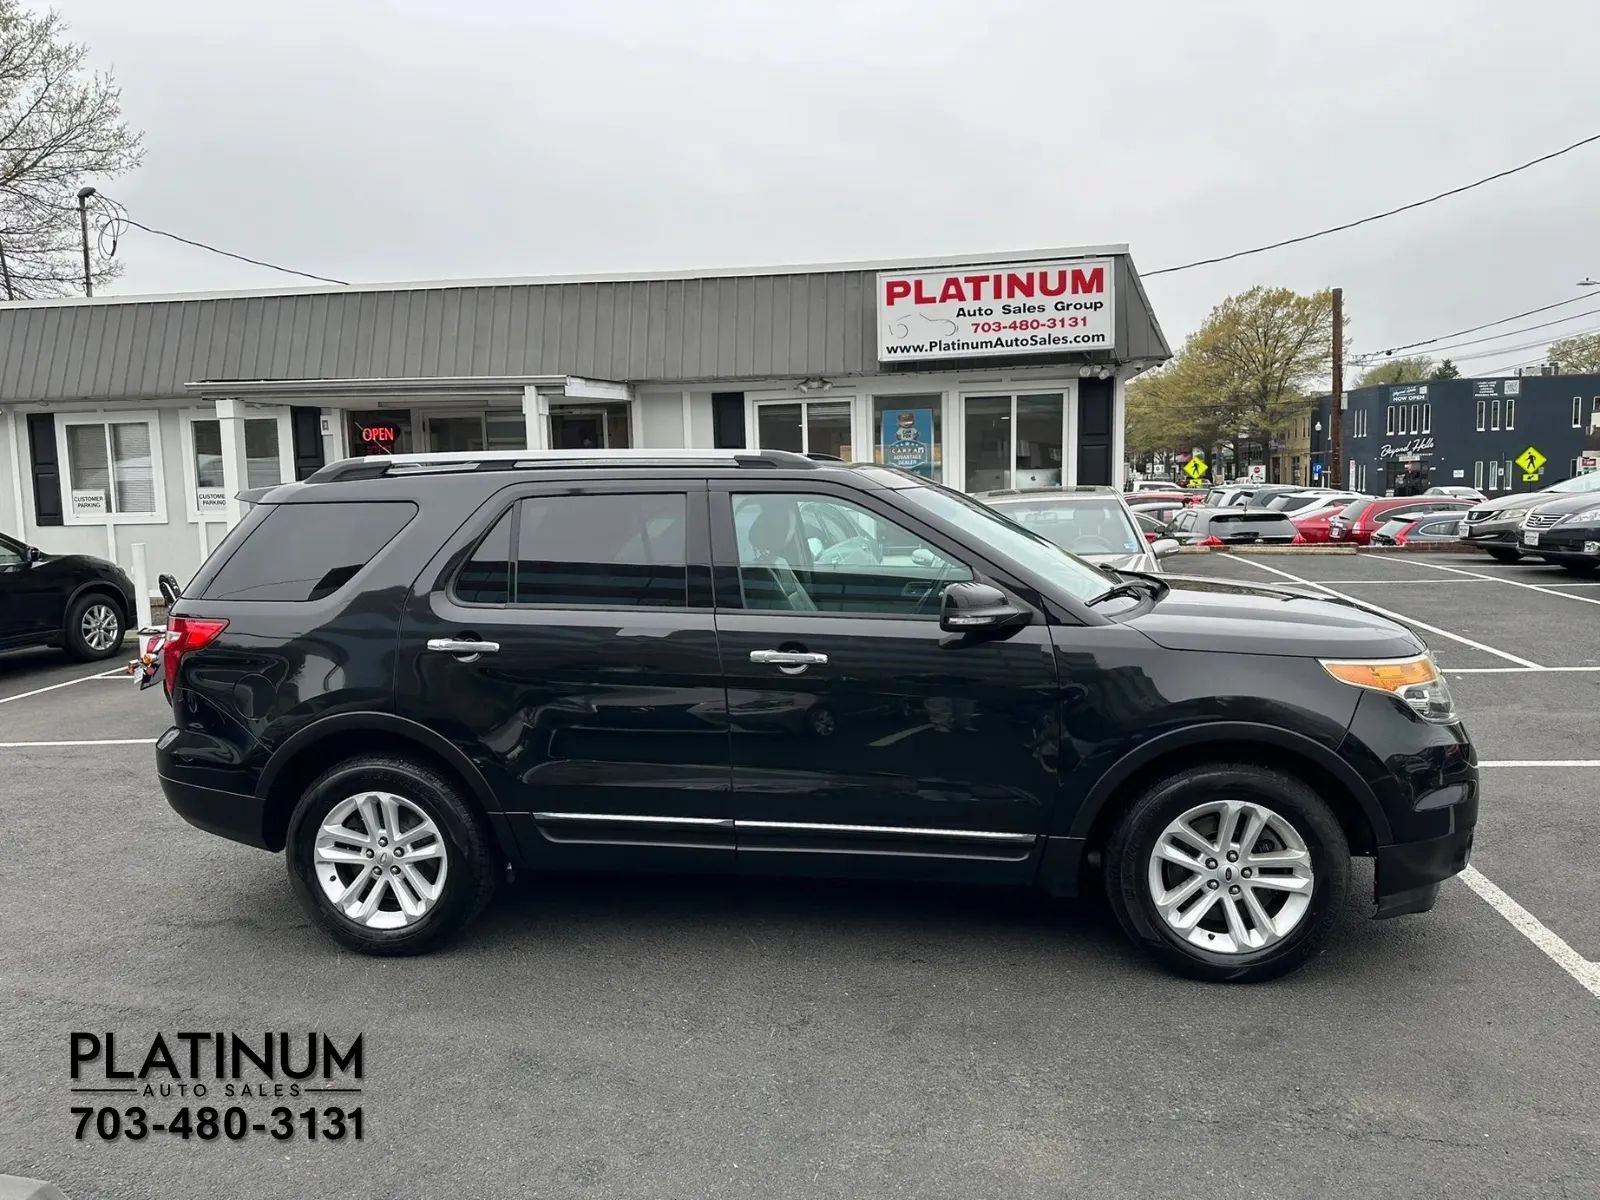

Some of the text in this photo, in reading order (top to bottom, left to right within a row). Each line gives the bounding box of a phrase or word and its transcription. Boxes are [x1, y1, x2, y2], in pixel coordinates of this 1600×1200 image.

[886, 267, 1104, 306] PLATINUM
[956, 300, 1104, 318] Auto Sales Group
[971, 316, 1088, 333] 703-480-3131
[886, 333, 1106, 354] www.PlatinumAutoSales.com
[362, 427, 394, 441] OPEN
